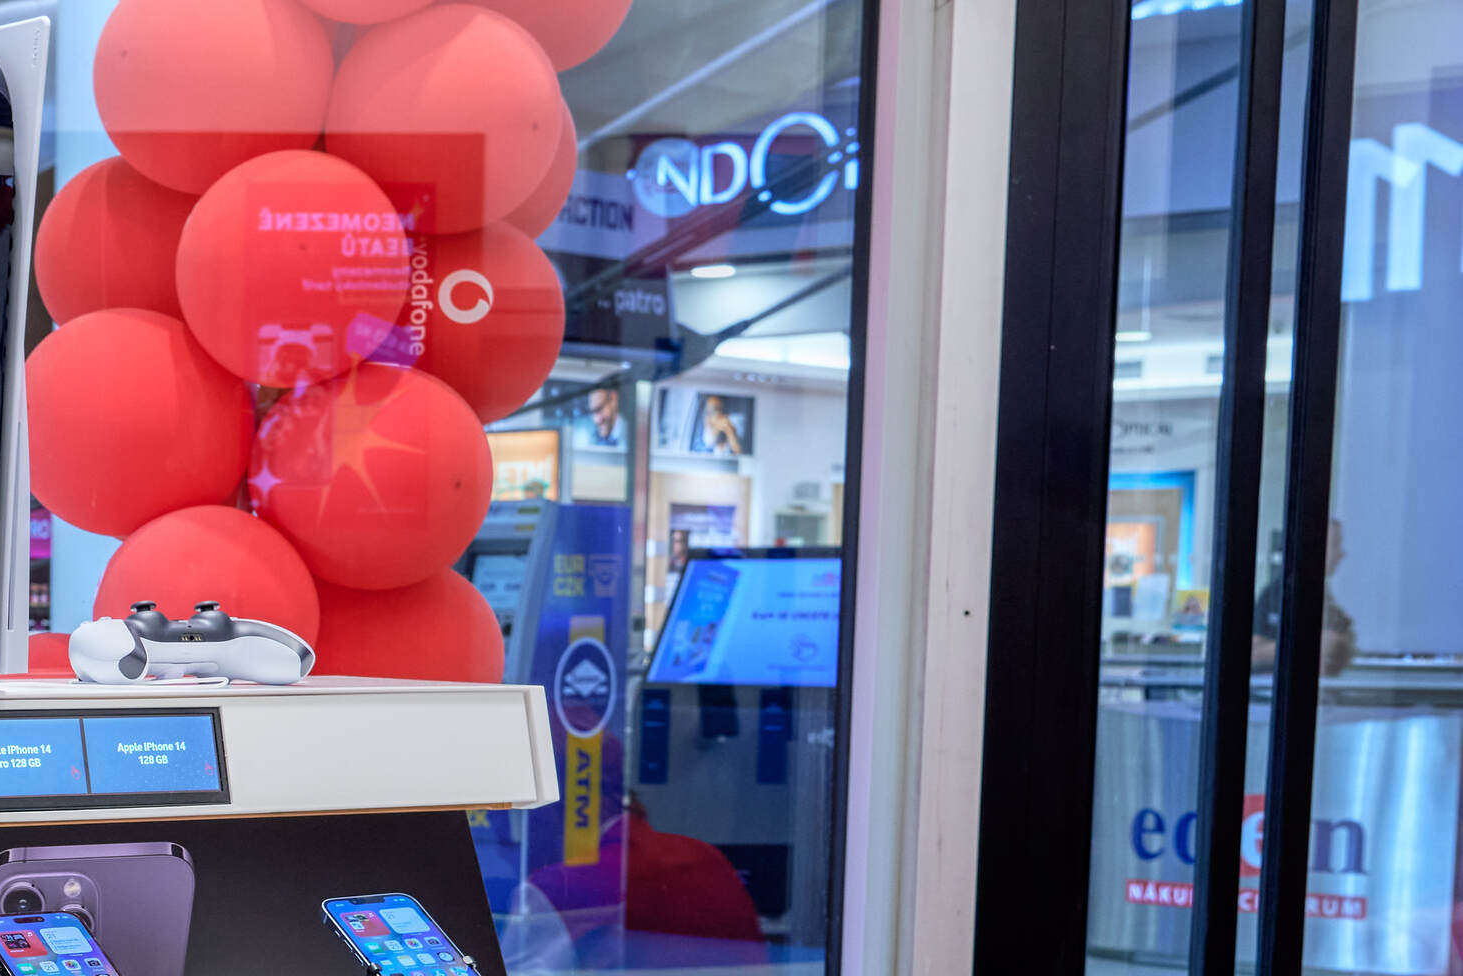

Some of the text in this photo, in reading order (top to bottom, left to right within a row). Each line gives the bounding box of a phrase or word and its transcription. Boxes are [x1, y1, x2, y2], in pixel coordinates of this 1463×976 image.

[409, 242, 434, 356] vodafone
[7, 744, 39, 755] iPhone
[40, 744, 51, 754] 14
[117, 741, 186, 753] Apple iPhone 14
[10, 758, 27, 768] 128
[28, 758, 41, 767] GB
[138, 755, 169, 765] 128 GB
[574, 747, 592, 829] ATM
